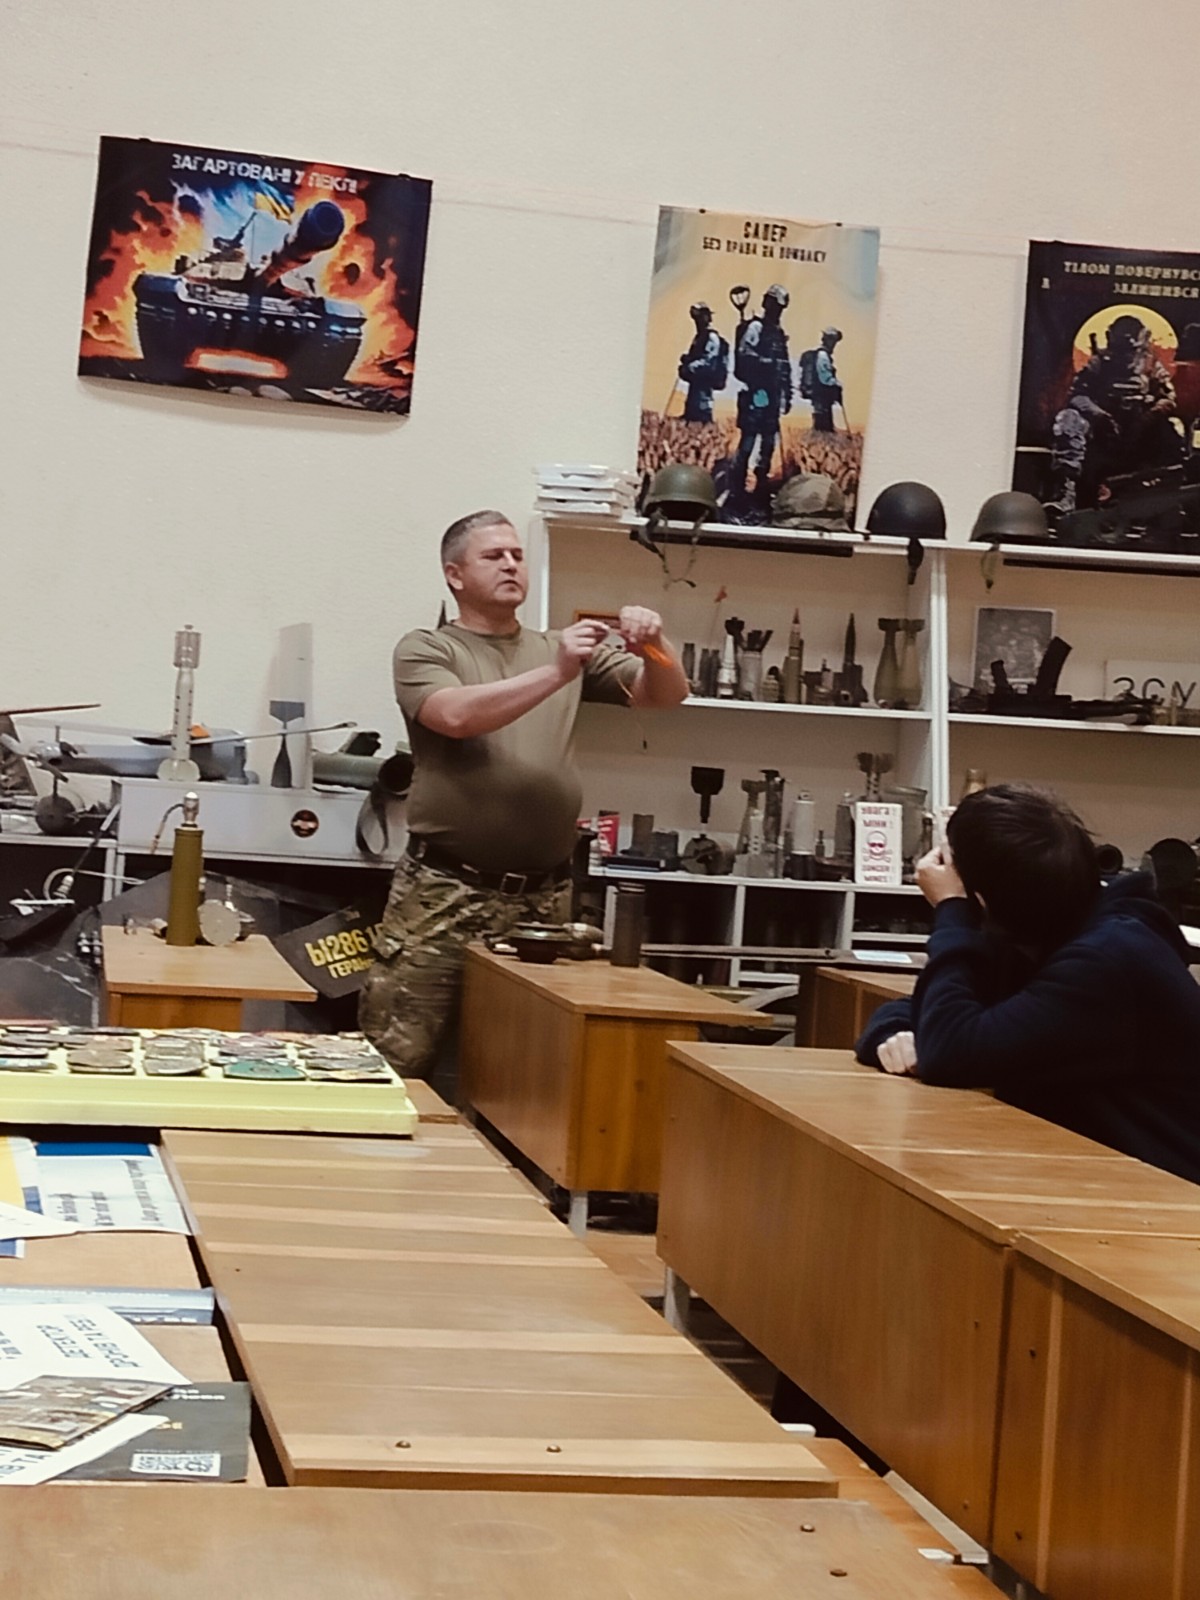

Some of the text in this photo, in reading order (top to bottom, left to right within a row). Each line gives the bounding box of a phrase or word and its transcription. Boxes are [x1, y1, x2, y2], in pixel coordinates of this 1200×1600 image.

[172, 154, 358, 193] ЗАГАРТОВАНІ У ПЕКЛІ
[743, 221, 788, 242] САПЕР
[703, 236, 721, 251] БЕЗ
[726, 240, 757, 255] ПРАВА
[762, 244, 774, 258] НА
[1114, 264, 1200, 281] ПОВЕРНУВС
